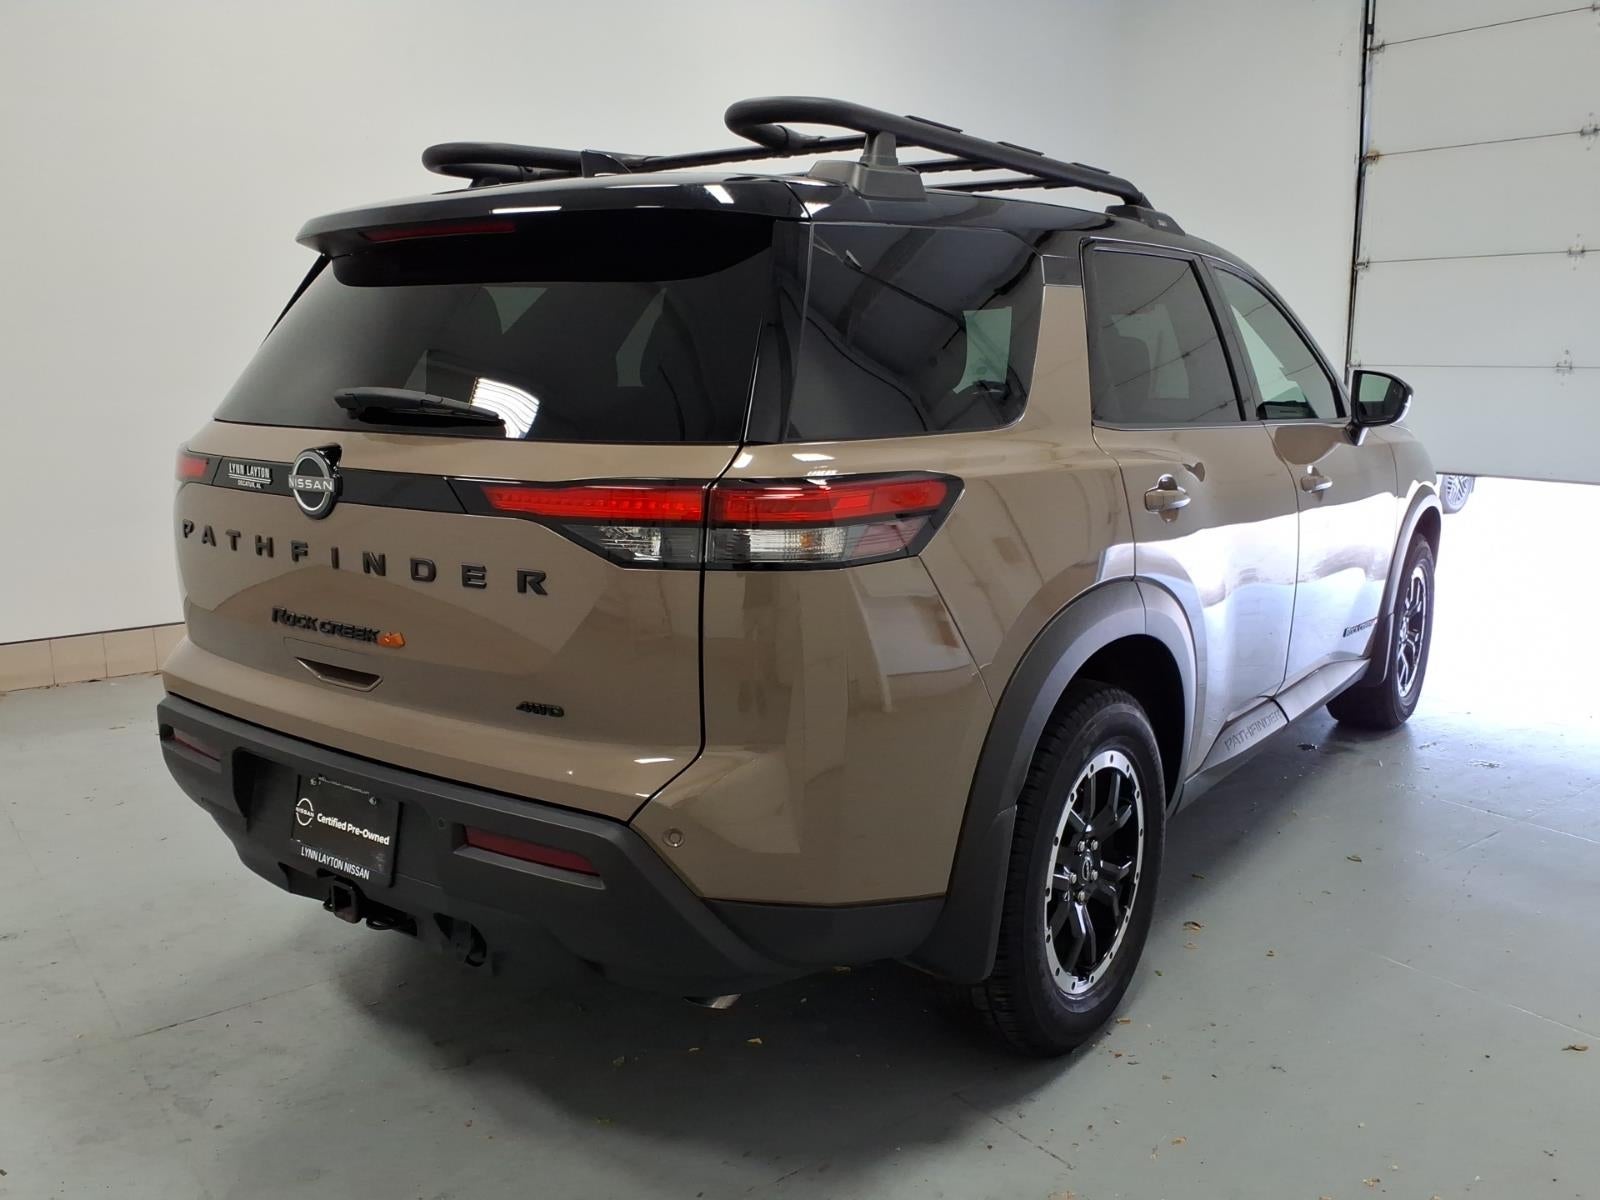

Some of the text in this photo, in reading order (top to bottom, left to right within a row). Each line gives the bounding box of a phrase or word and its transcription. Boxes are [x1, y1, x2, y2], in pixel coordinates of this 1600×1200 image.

[228, 462, 270, 479] LYNN LAYTON
[288, 476, 334, 491] NISSAN
[182, 519, 548, 596] PATHFINDER
[1224, 710, 1282, 750] PATHFINDER
[295, 806, 315, 817] NISSAN
[317, 813, 390, 845] Certified Pre-Owned
[301, 846, 370, 880] LYNN LAYTON NISSAN
